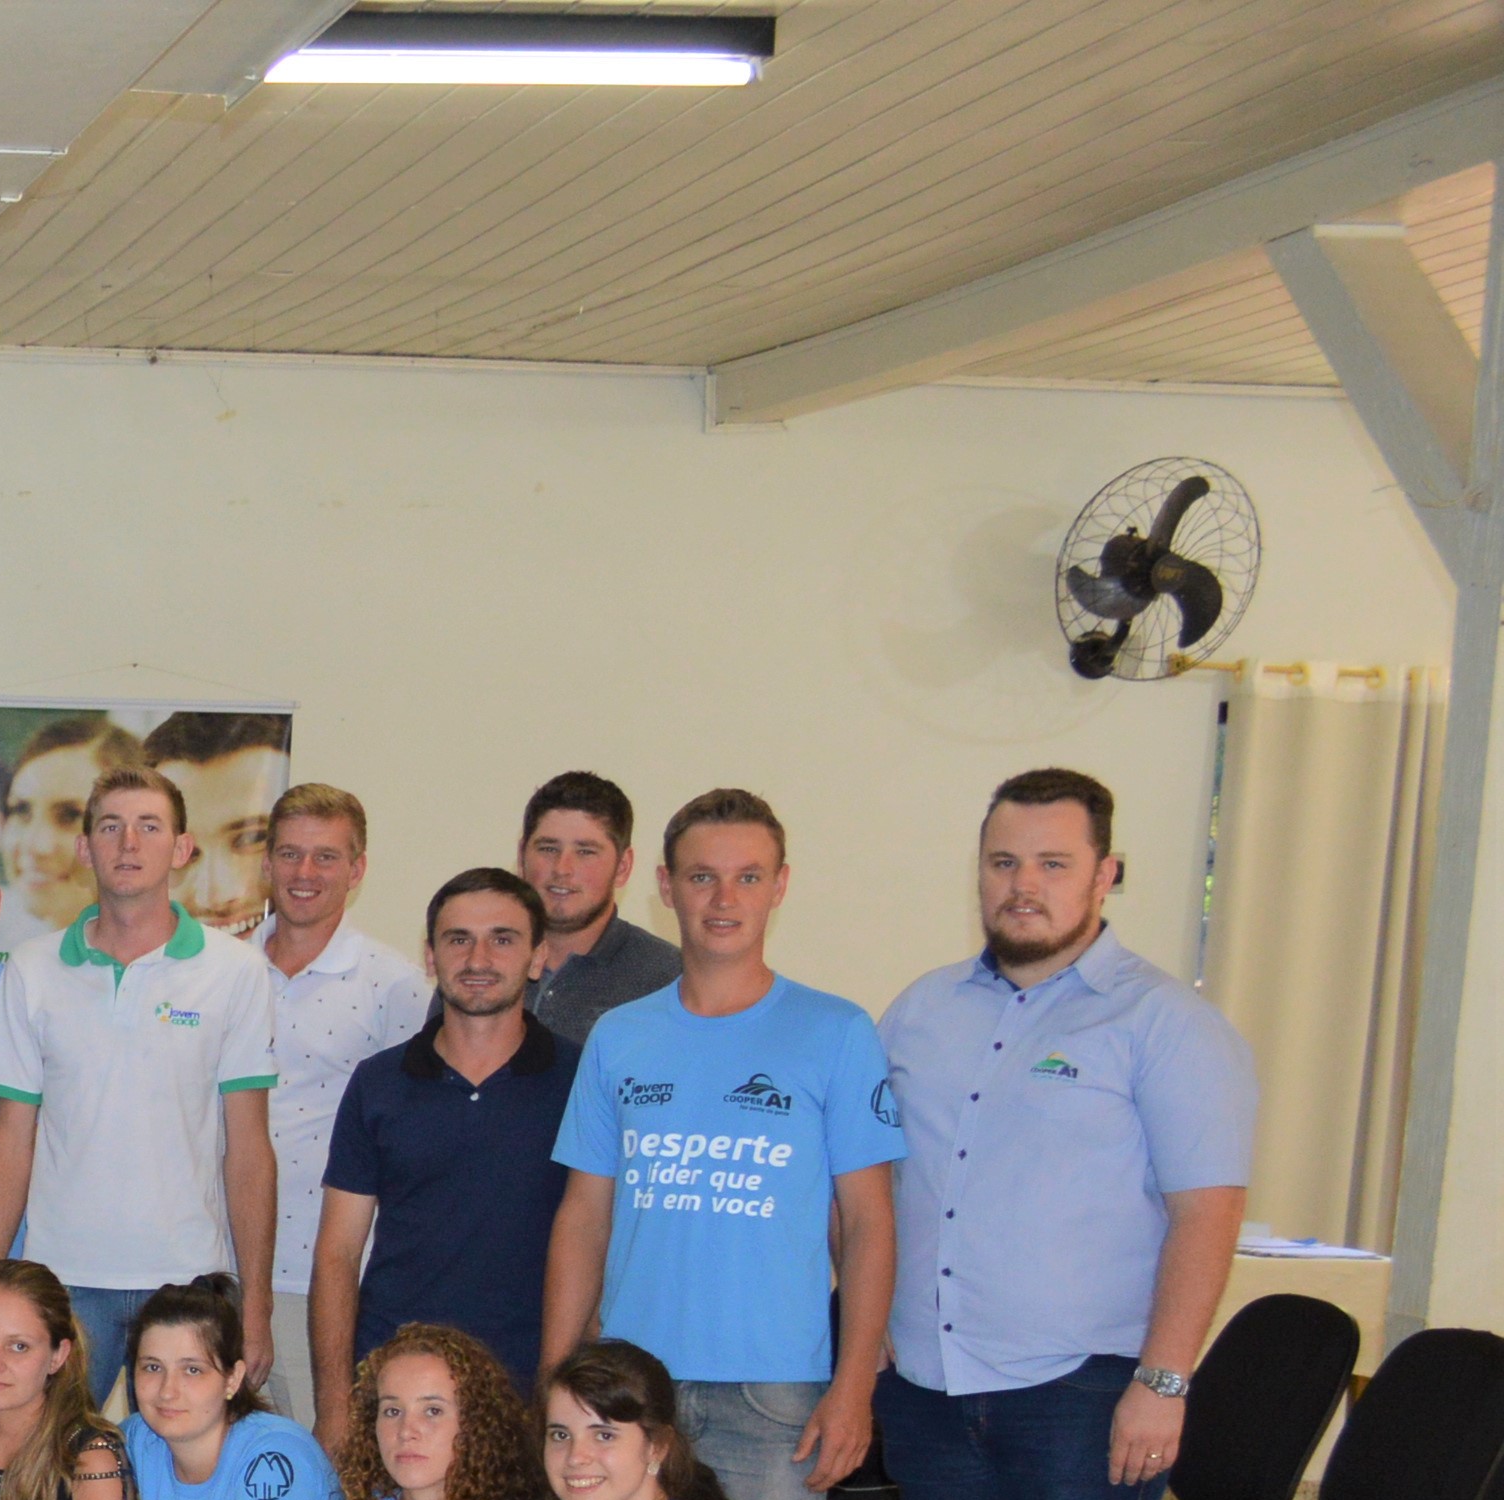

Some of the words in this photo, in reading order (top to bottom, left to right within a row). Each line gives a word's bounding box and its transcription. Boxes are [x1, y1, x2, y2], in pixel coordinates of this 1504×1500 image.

[631, 1083, 673, 1097] jovem
[634, 1092, 672, 1105] coop
[723, 1094, 762, 1105] COOPER
[765, 1093, 791, 1110] A1
[623, 1129, 792, 1167] Desperte
[625, 1169, 639, 1184] o
[648, 1161, 702, 1184] líder
[710, 1170, 761, 1192] que
[663, 1193, 701, 1211] em
[712, 1196, 775, 1218] você
